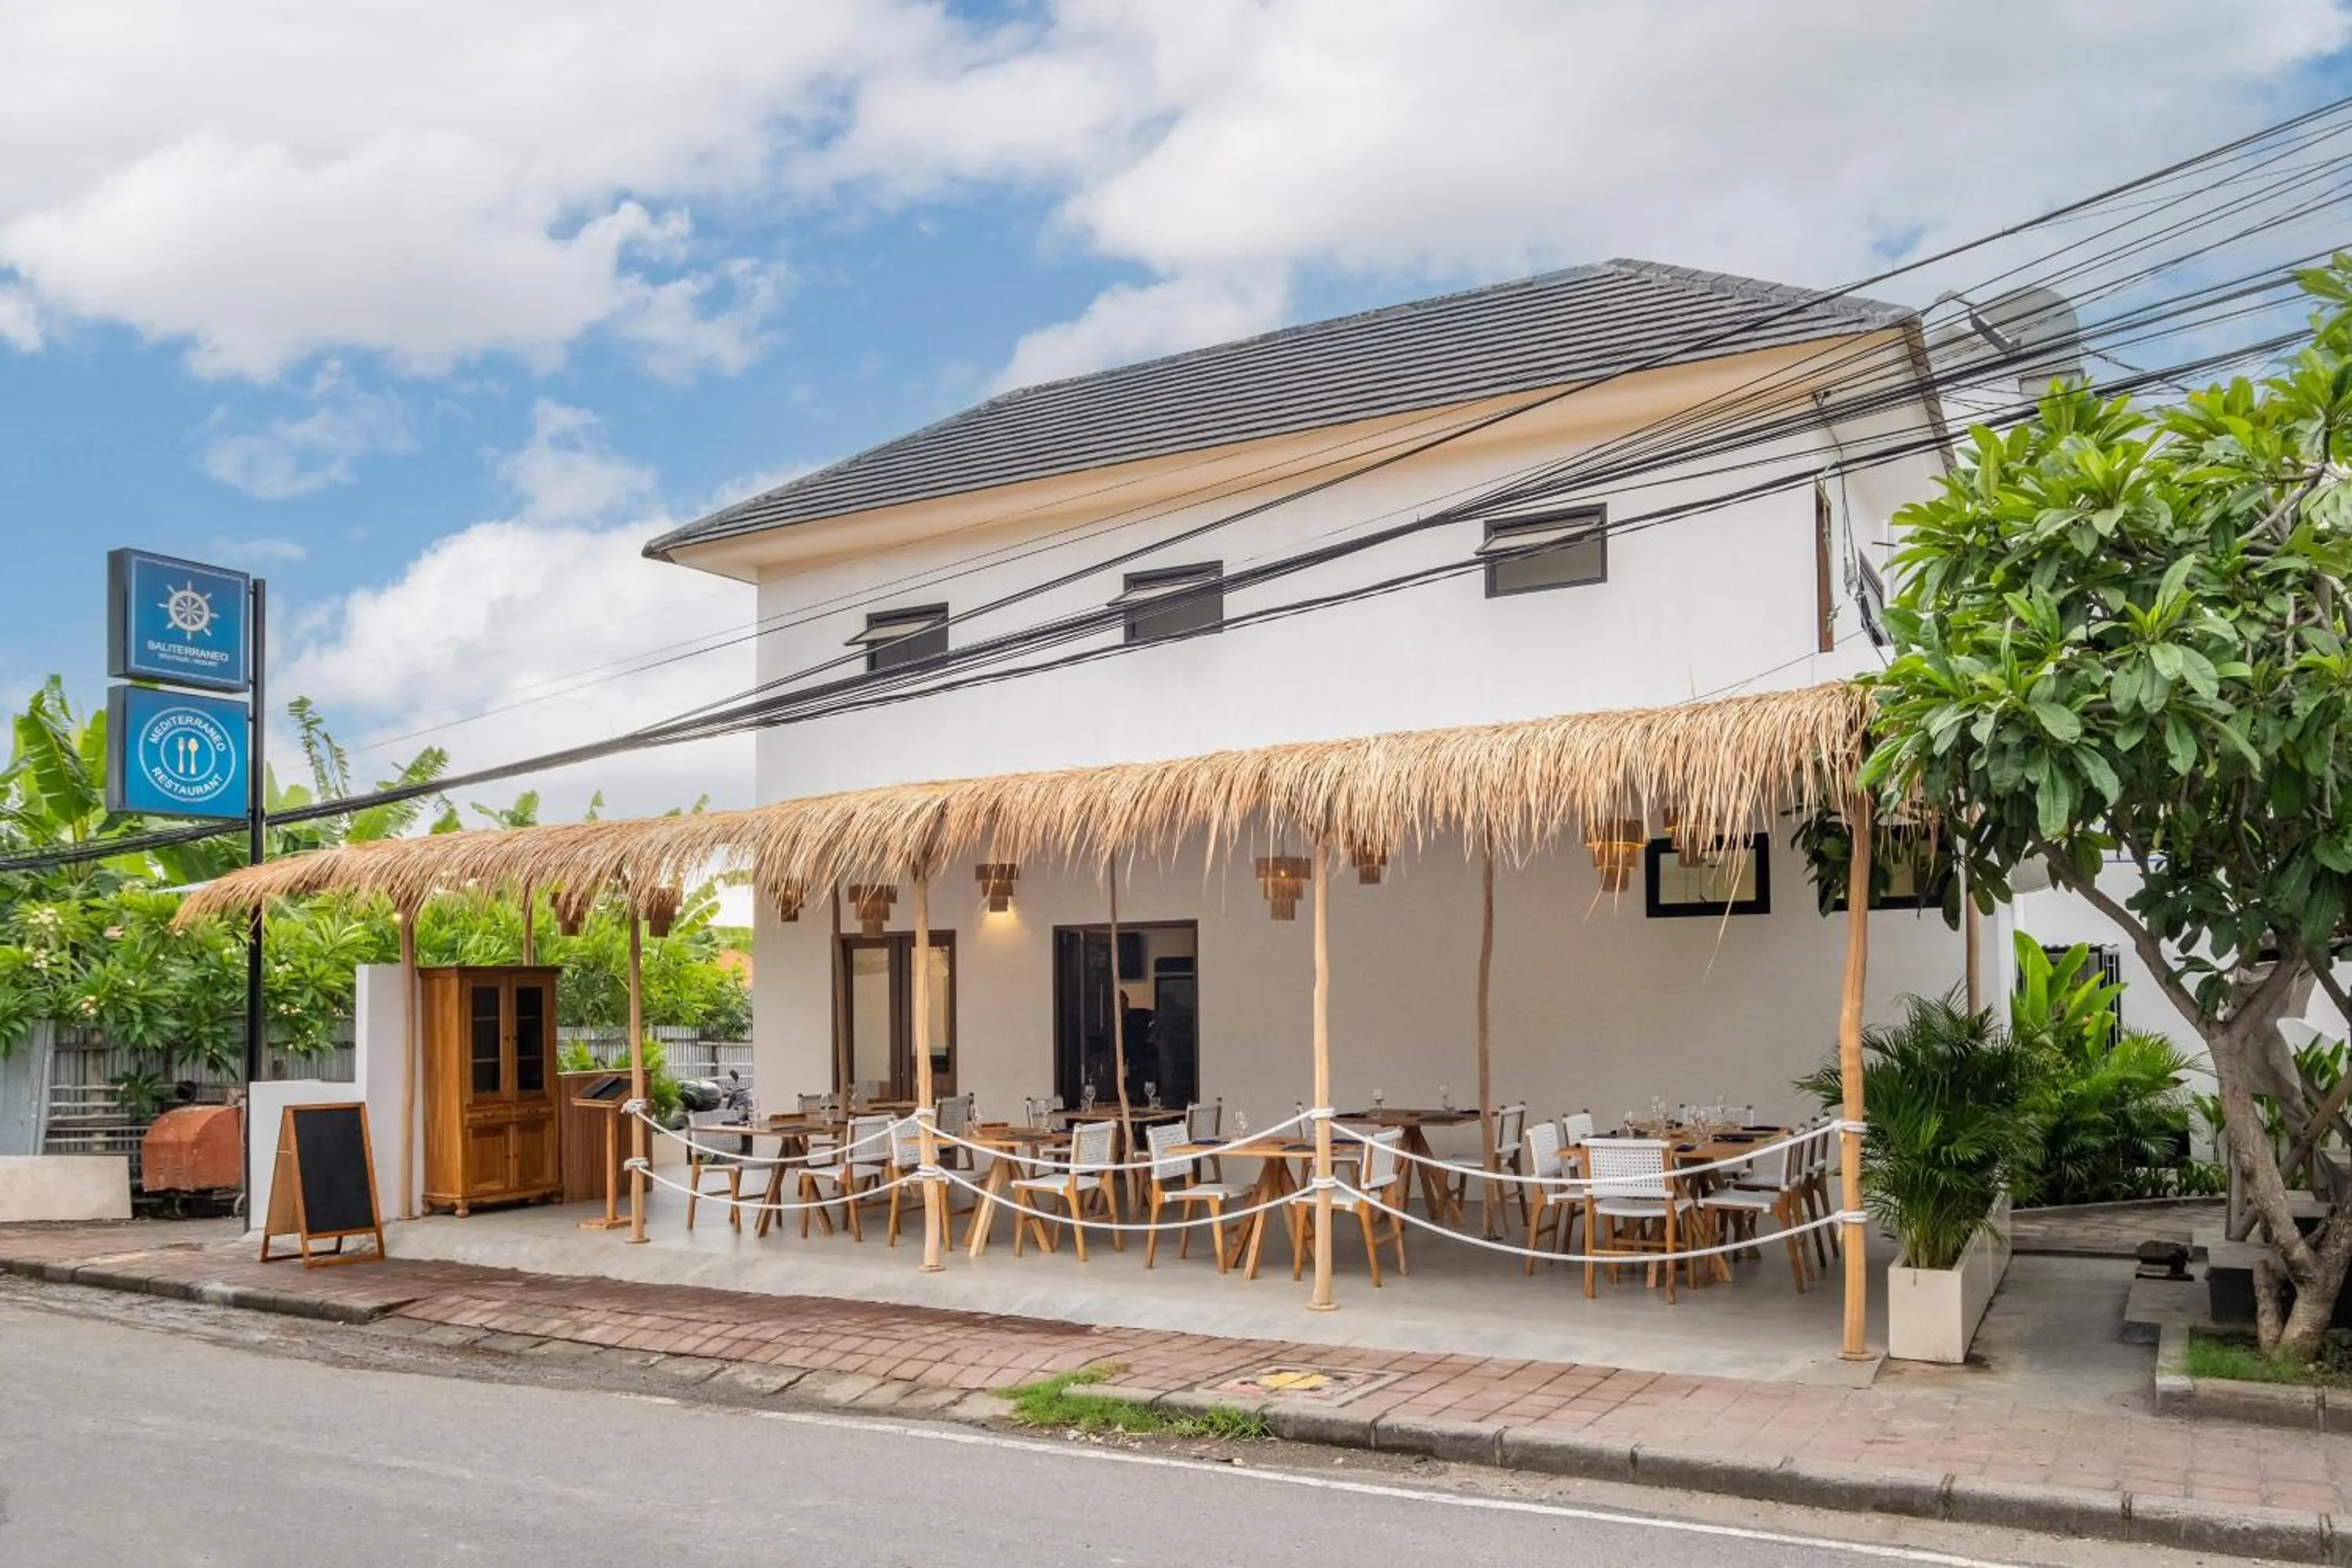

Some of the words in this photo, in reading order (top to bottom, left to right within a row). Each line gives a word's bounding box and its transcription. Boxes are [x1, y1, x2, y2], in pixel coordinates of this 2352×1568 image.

[147, 640, 228, 662] BALITERRANEO
[149, 714, 227, 752] MEDITERRANEO
[151, 766, 223, 796] RESTAURANT
